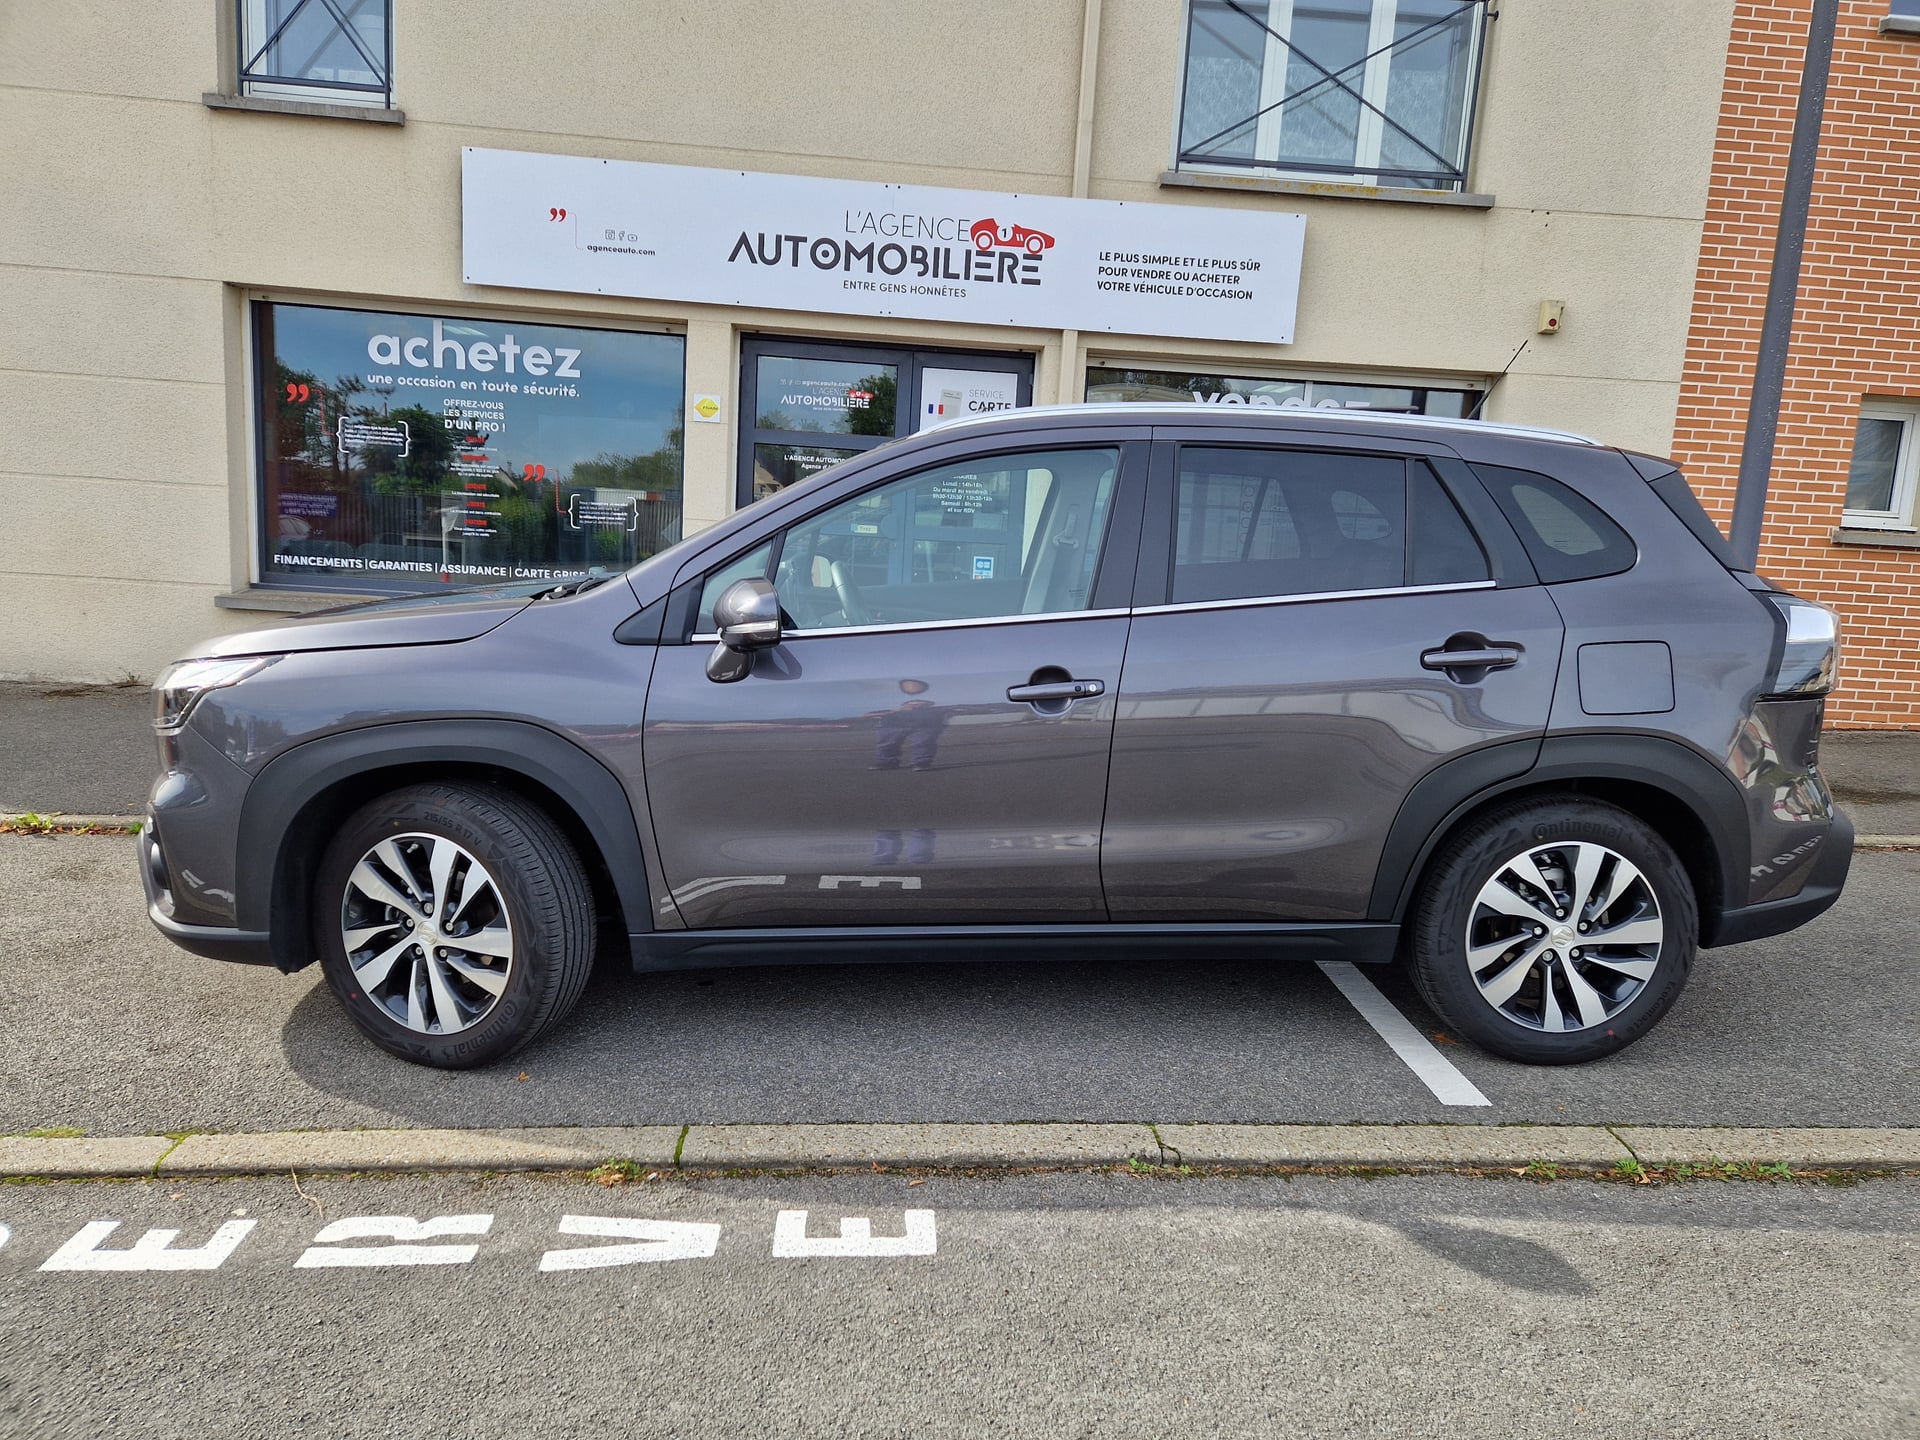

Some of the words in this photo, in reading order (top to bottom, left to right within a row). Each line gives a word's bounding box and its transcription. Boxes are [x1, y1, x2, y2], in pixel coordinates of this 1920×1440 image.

[845, 209, 971, 242] L'AGENCE
[586, 244, 656, 257] agenceauto.com
[1099, 251, 1111, 262] LE
[1113, 252, 1140, 263] PLUS
[1142, 254, 1181, 266] SIMPLE
[1183, 257, 1196, 267] ET
[1197, 258, 1209, 268] LE
[1211, 259, 1238, 270] PLUS
[1239, 258, 1261, 271] SÛR
[1098, 266, 1128, 277] POUR
[1130, 268, 1172, 280] VENDRE
[1173, 271, 1190, 281] OU
[1191, 272, 1241, 285] ACHETER
[843, 279, 876, 291] ENTRE
[879, 282, 907, 294] GENS
[910, 284, 967, 298] HONNÊTES
[1097, 280, 1131, 292] VOTRE
[1133, 280, 1183, 296] VÉHICULE
[1186, 286, 1253, 300] D'OCCASION
[367, 319, 581, 378] achetez
[367, 374, 393, 384] une
[397, 374, 456, 389] occasion
[460, 380, 477, 390] en
[481, 379, 519, 393] toute
[523, 381, 580, 398] sécurité.
[812, 387, 849, 397] L'AGENCE
[968, 389, 1004, 399] SERVICE
[443, 398, 504, 410] OFFREZ-VOUS
[443, 408, 460, 417] LES
[461, 409, 505, 420] SERVICES
[444, 419, 472, 430] D'UN
[474, 421, 500, 432] PRO
[273, 554, 364, 569] FINANCEMENTS
[369, 559, 433, 573] GARANTIES
[439, 563, 508, 577] ASSURANCE
[514, 567, 551, 579] CARTE
[1532, 819, 1624, 840] Continental
[453, 999, 518, 1059] Continental
[0, 1208, 938, 1273] ERVE
